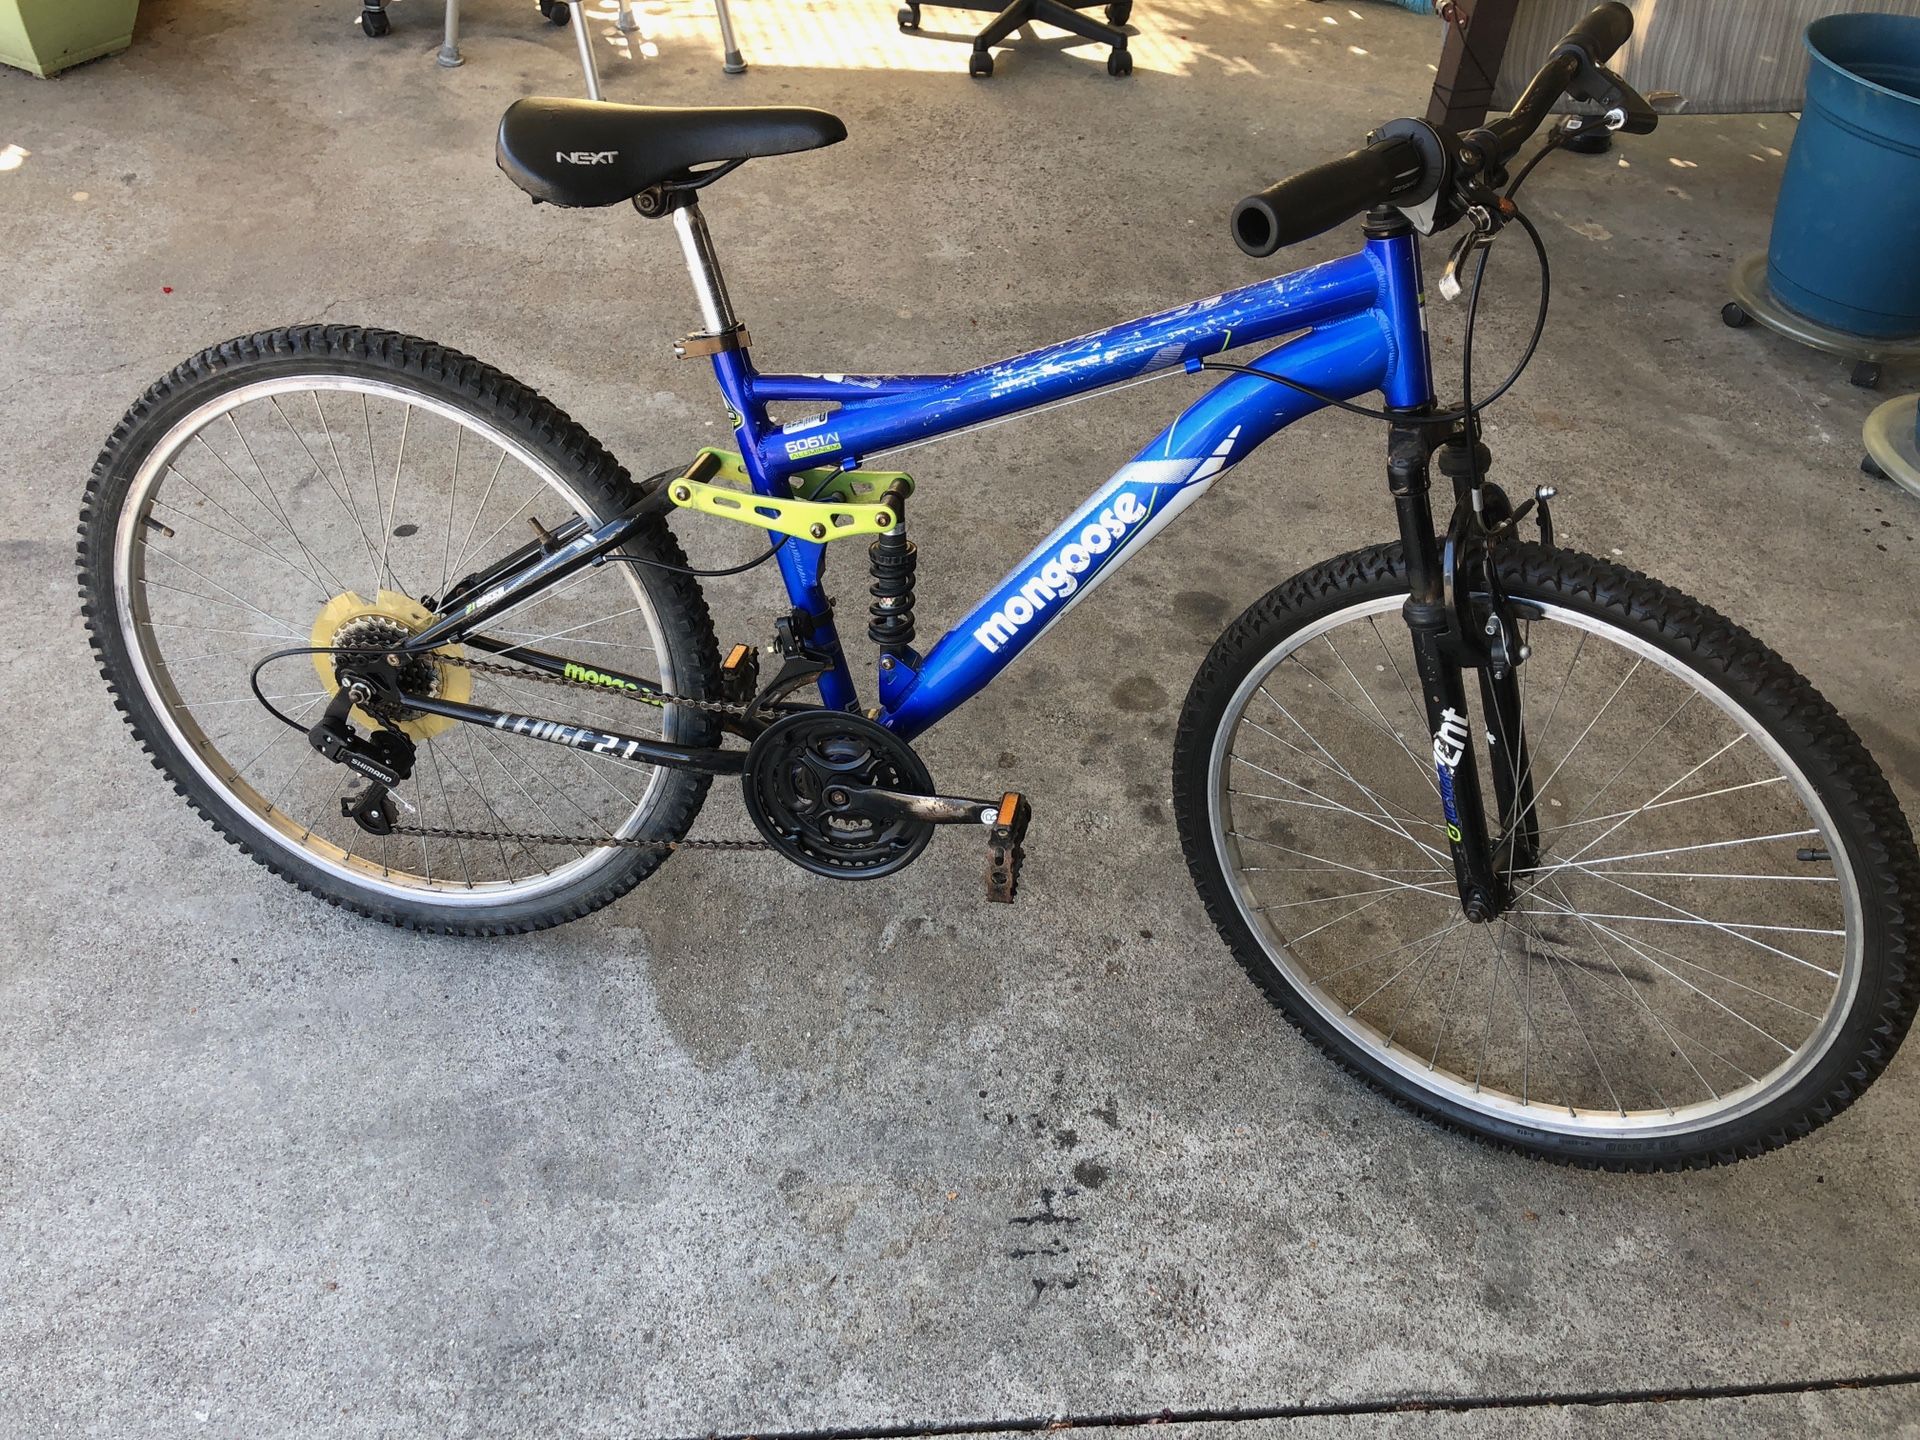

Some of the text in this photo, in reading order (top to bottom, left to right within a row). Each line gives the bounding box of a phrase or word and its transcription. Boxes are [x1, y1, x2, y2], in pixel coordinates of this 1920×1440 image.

[556, 150, 619, 166] NEXT
[973, 491, 1148, 654] mongoose
[592, 734, 640, 760] 2.1
[351, 757, 393, 783] SHIMANO
